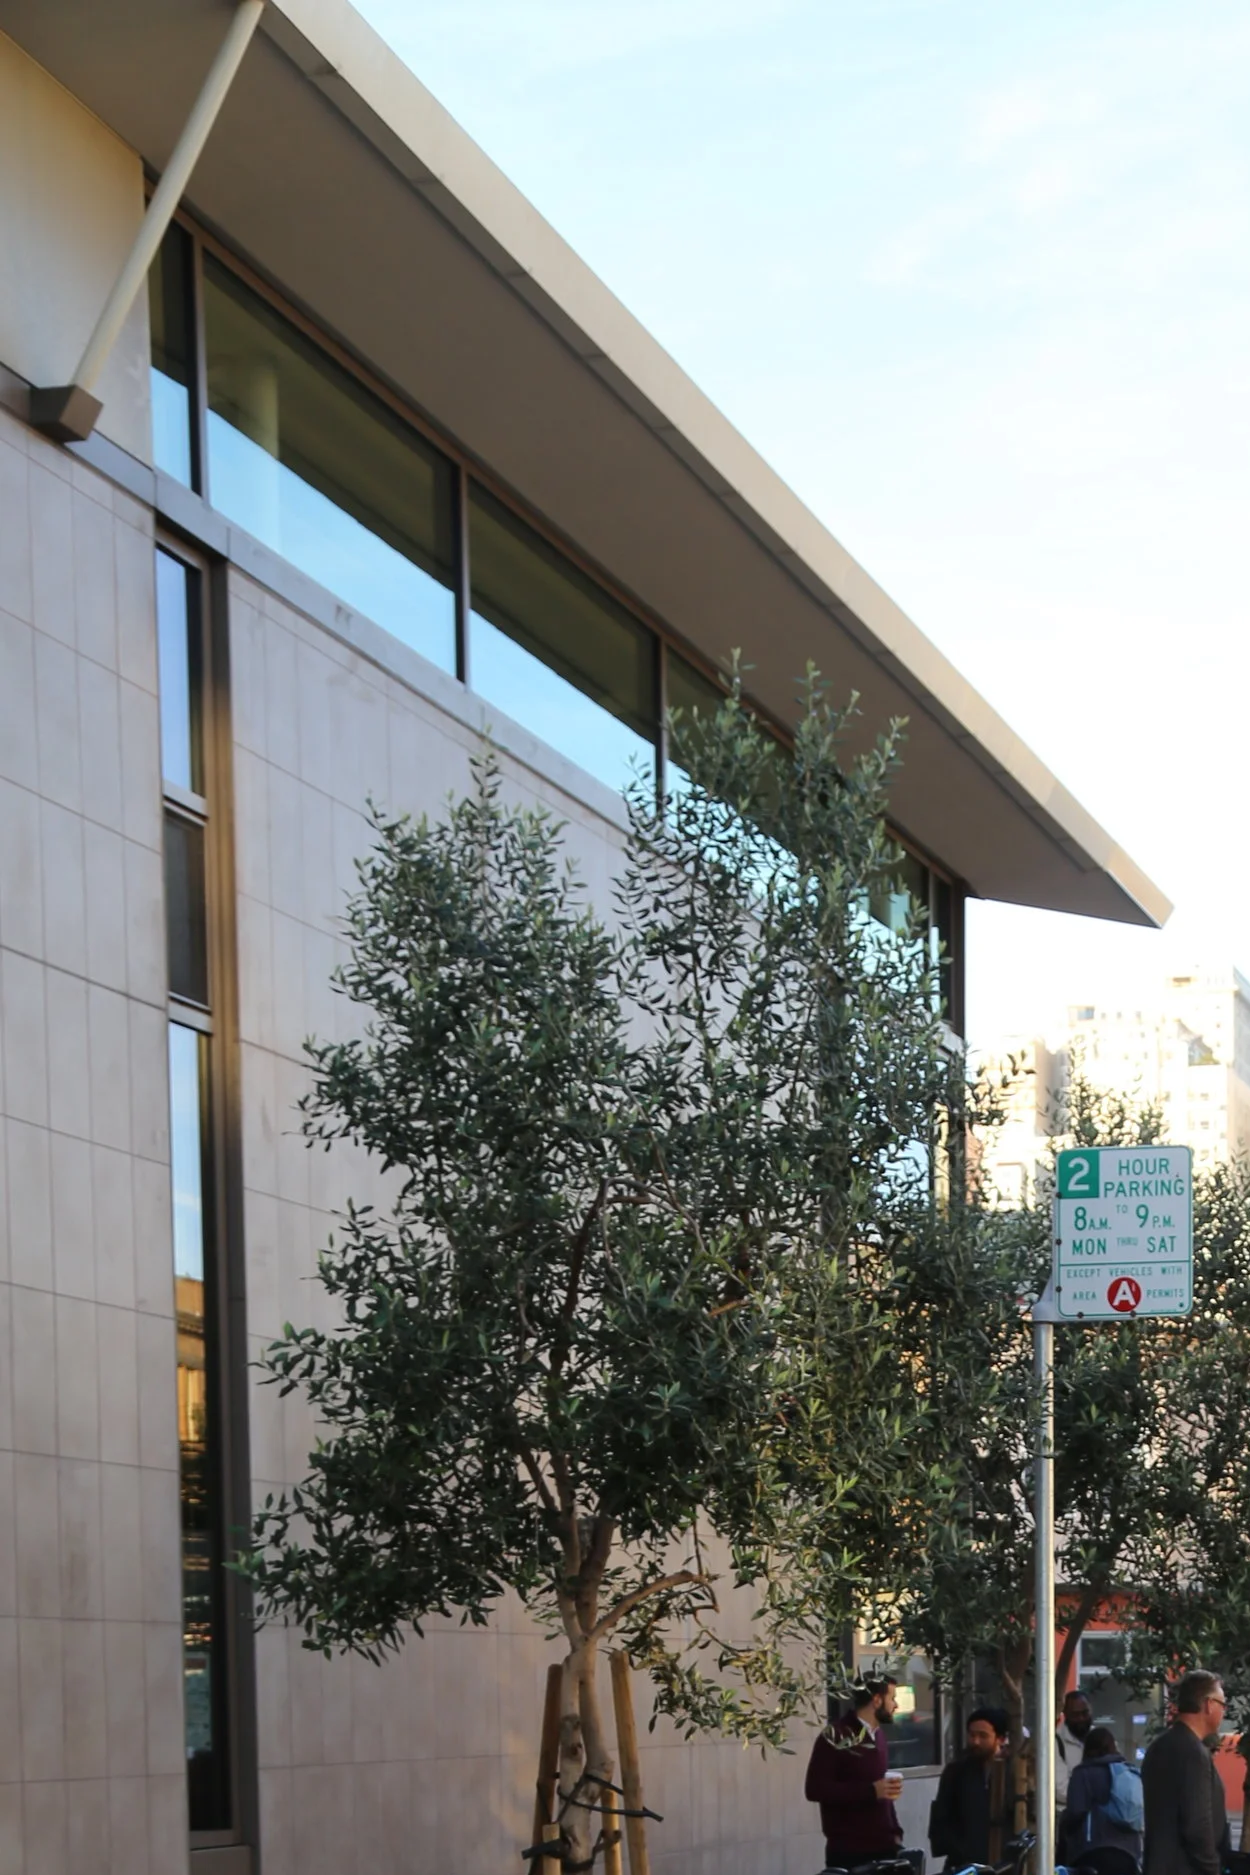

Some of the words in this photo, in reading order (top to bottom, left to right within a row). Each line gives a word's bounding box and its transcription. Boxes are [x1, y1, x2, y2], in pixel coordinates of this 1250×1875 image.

[1067, 1157, 1090, 1191] 2
[1118, 1158, 1169, 1176] HOUR
[1104, 1178, 1185, 1198] PARKING
[1073, 1206, 1087, 1231] 8
[1116, 1204, 1128, 1214] TO
[1136, 1203, 1149, 1228] 9
[1072, 1238, 1107, 1256] MON
[1116, 1236, 1138, 1247] THRU
[1147, 1235, 1177, 1253] SAT
[1067, 1268, 1100, 1278] EXCEPT
[1109, 1266, 1153, 1277] VEHICLES
[1161, 1265, 1182, 1275] WITH
[1072, 1291, 1097, 1301] AREA
[1113, 1279, 1136, 1306] A
[1146, 1288, 1185, 1299] PERMITS
